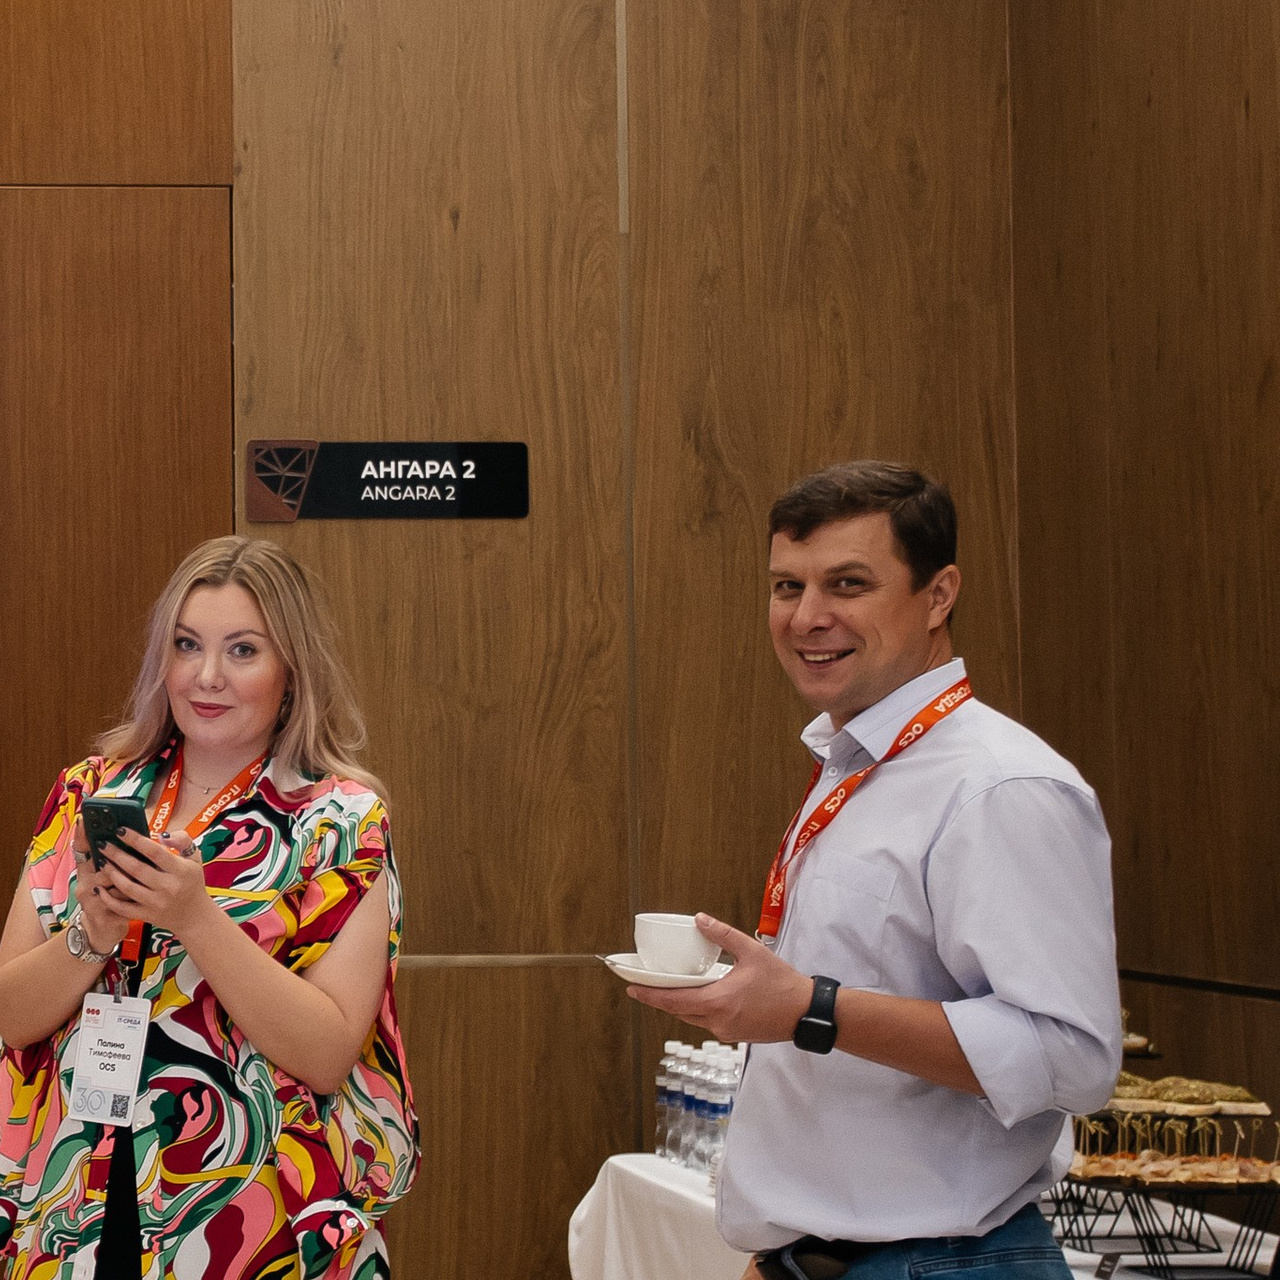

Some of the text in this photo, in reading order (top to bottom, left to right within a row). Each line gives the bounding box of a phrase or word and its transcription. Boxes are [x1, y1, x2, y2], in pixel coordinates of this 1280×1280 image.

[361, 460, 476, 479] АНГАРА 2
[361, 486, 456, 500] ANGARA 2
[898, 723, 924, 748] OCS
[824, 787, 846, 814] OCS
[99, 1062, 116, 1071] OCS
